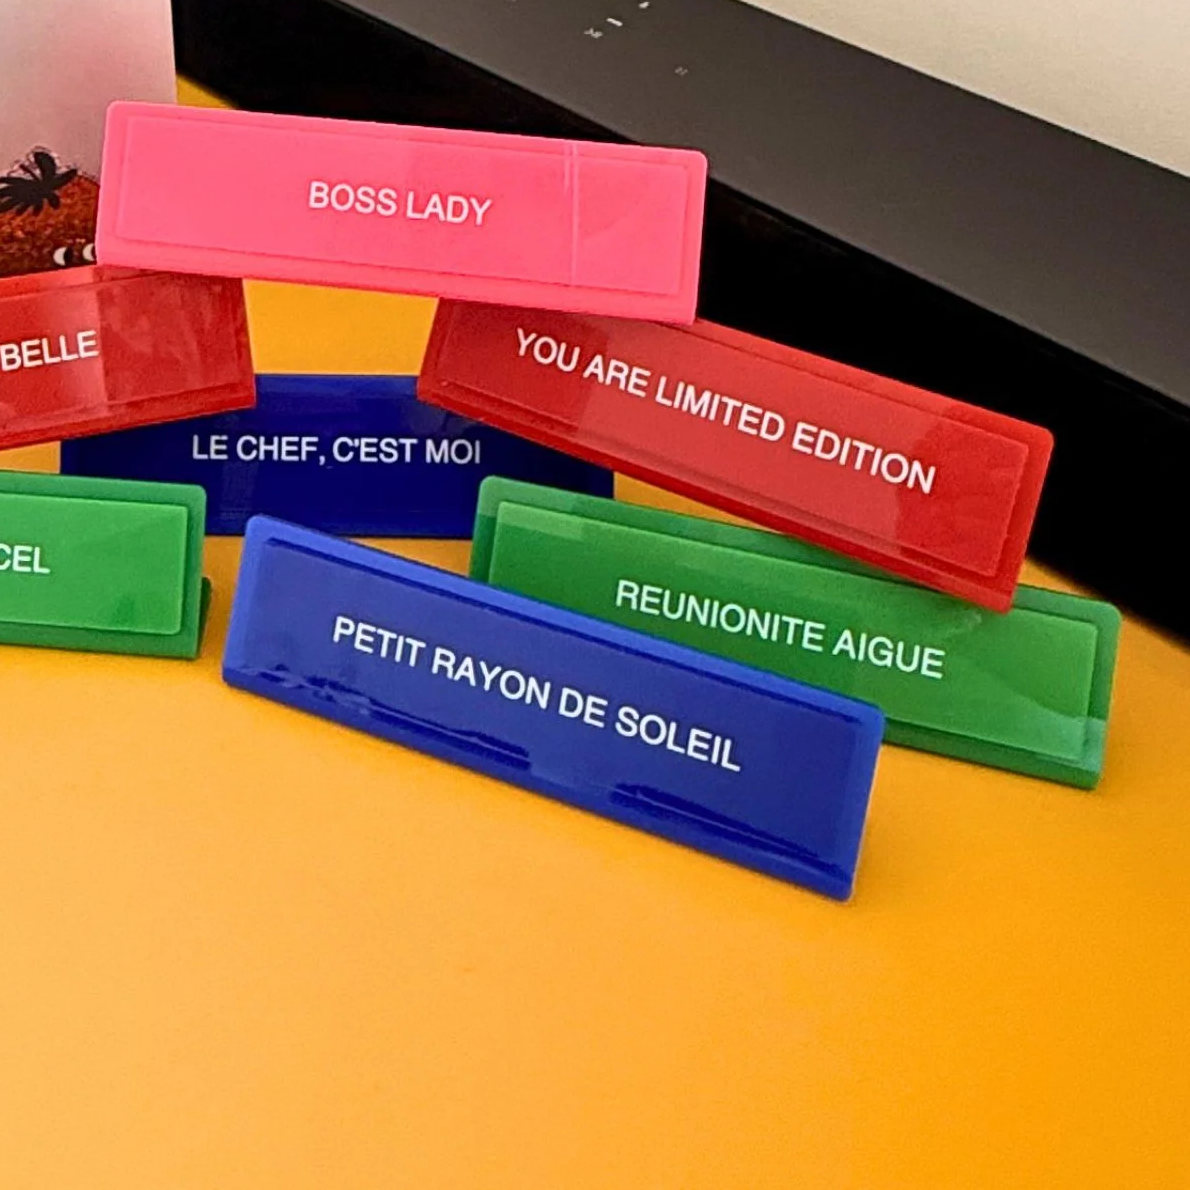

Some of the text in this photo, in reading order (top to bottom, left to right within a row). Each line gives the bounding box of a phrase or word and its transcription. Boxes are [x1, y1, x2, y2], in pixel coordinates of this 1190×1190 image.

[309, 180, 493, 226] BOSS LADY
[0, 329, 99, 372] BELLE
[516, 328, 937, 494] YOU ARE LIMITED EDITION
[192, 434, 481, 466] LE CHEF, C'EST MOI
[615, 579, 946, 679] REUNIONITE AIGUE
[332, 616, 742, 773] PETIT RAYON DE SOLEIL
